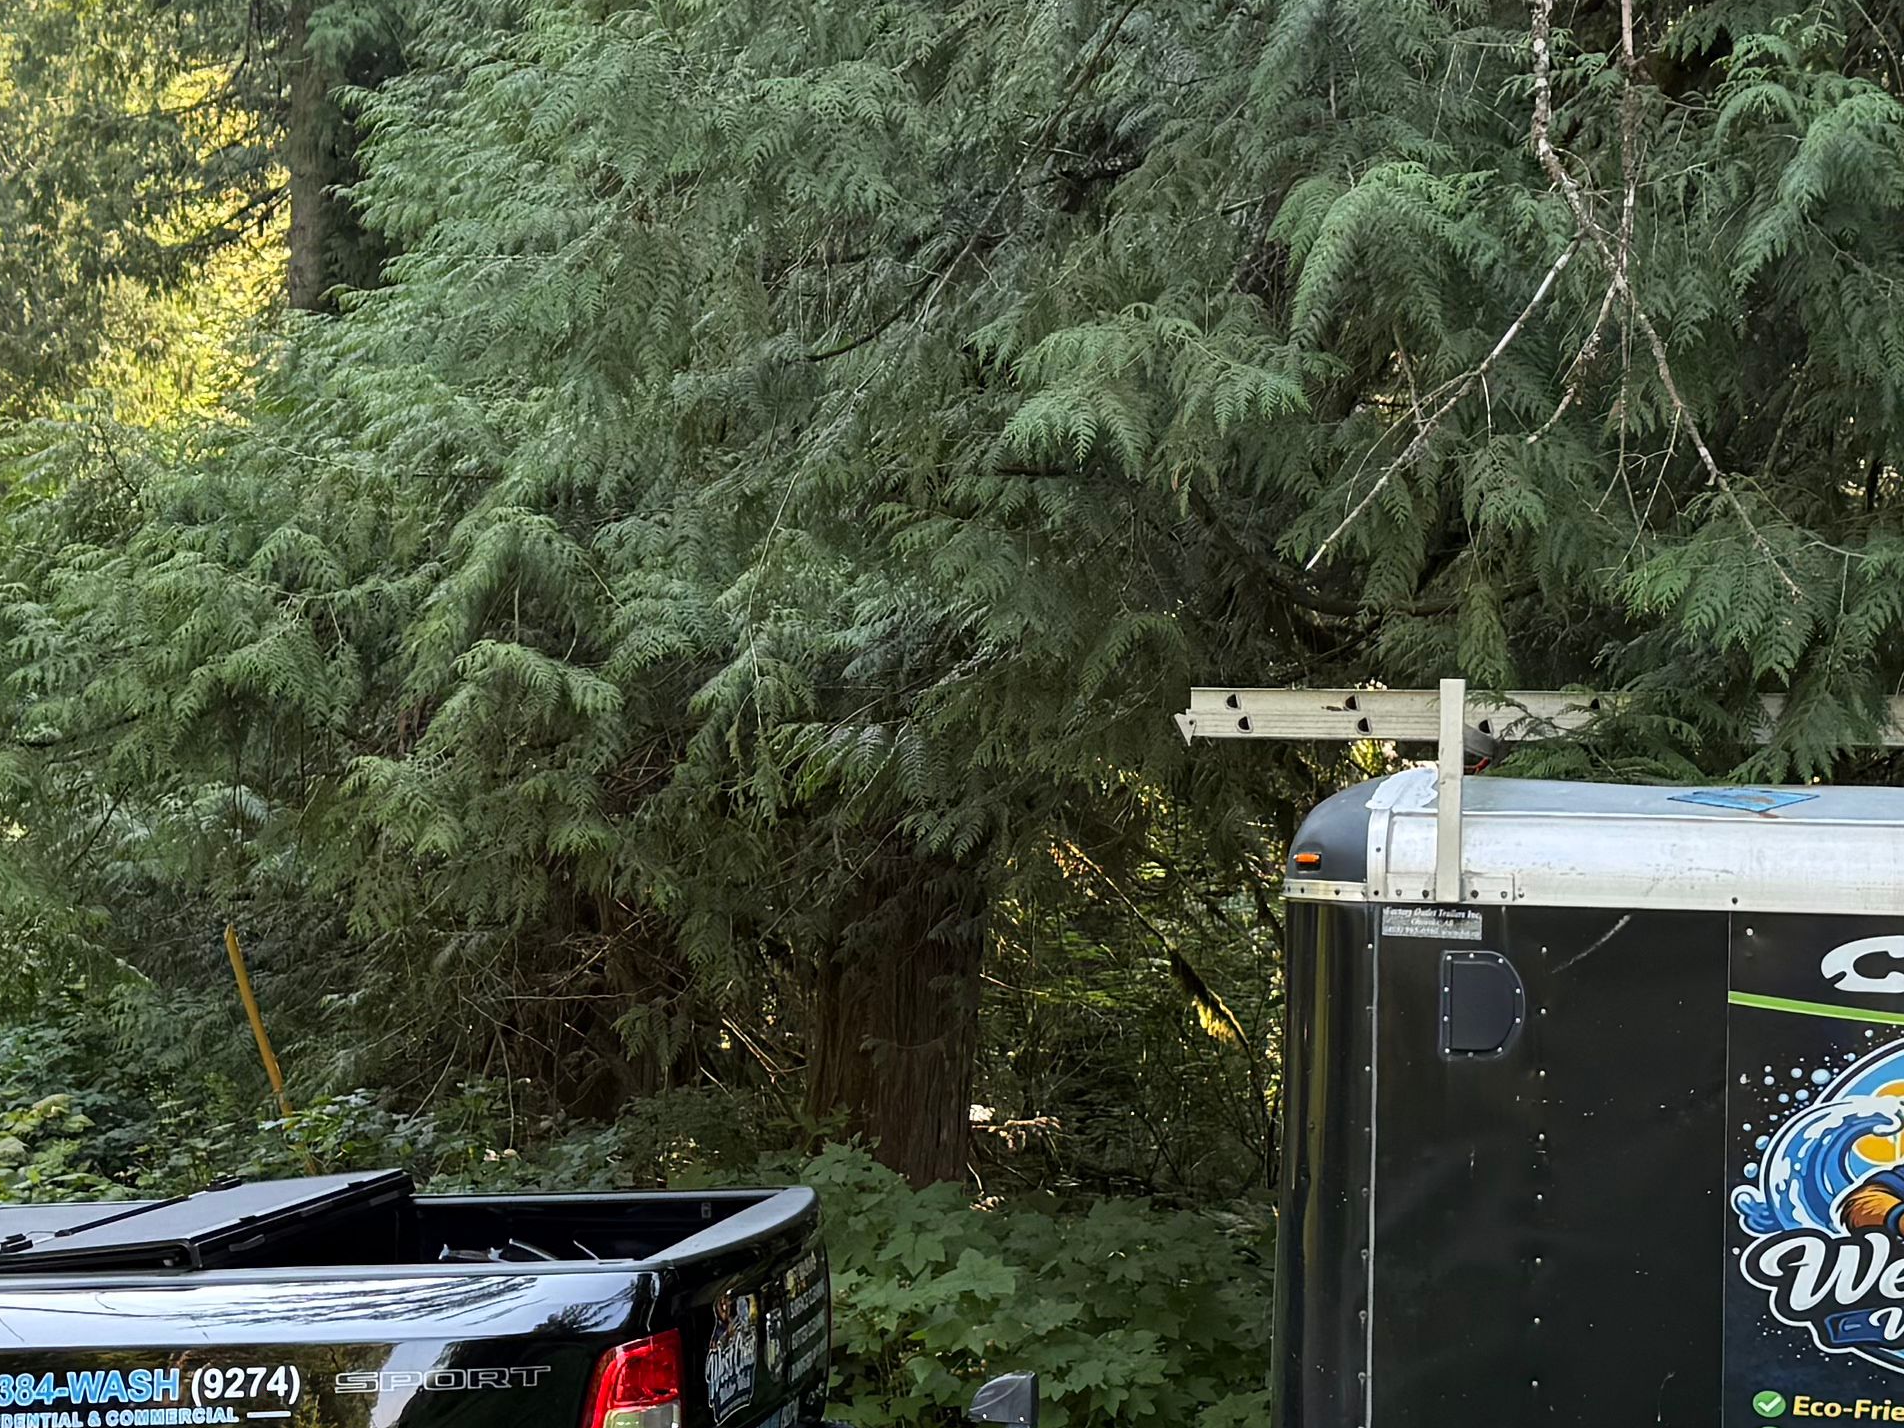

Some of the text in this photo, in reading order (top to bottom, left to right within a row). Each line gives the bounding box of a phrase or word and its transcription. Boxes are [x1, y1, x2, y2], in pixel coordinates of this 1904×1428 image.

[191, 1365, 300, 1406] (9274)
[335, 1366, 551, 1394] SPORT
[88, 1410, 101, 1427] &
[106, 1407, 239, 1427] COMMERCIAL
